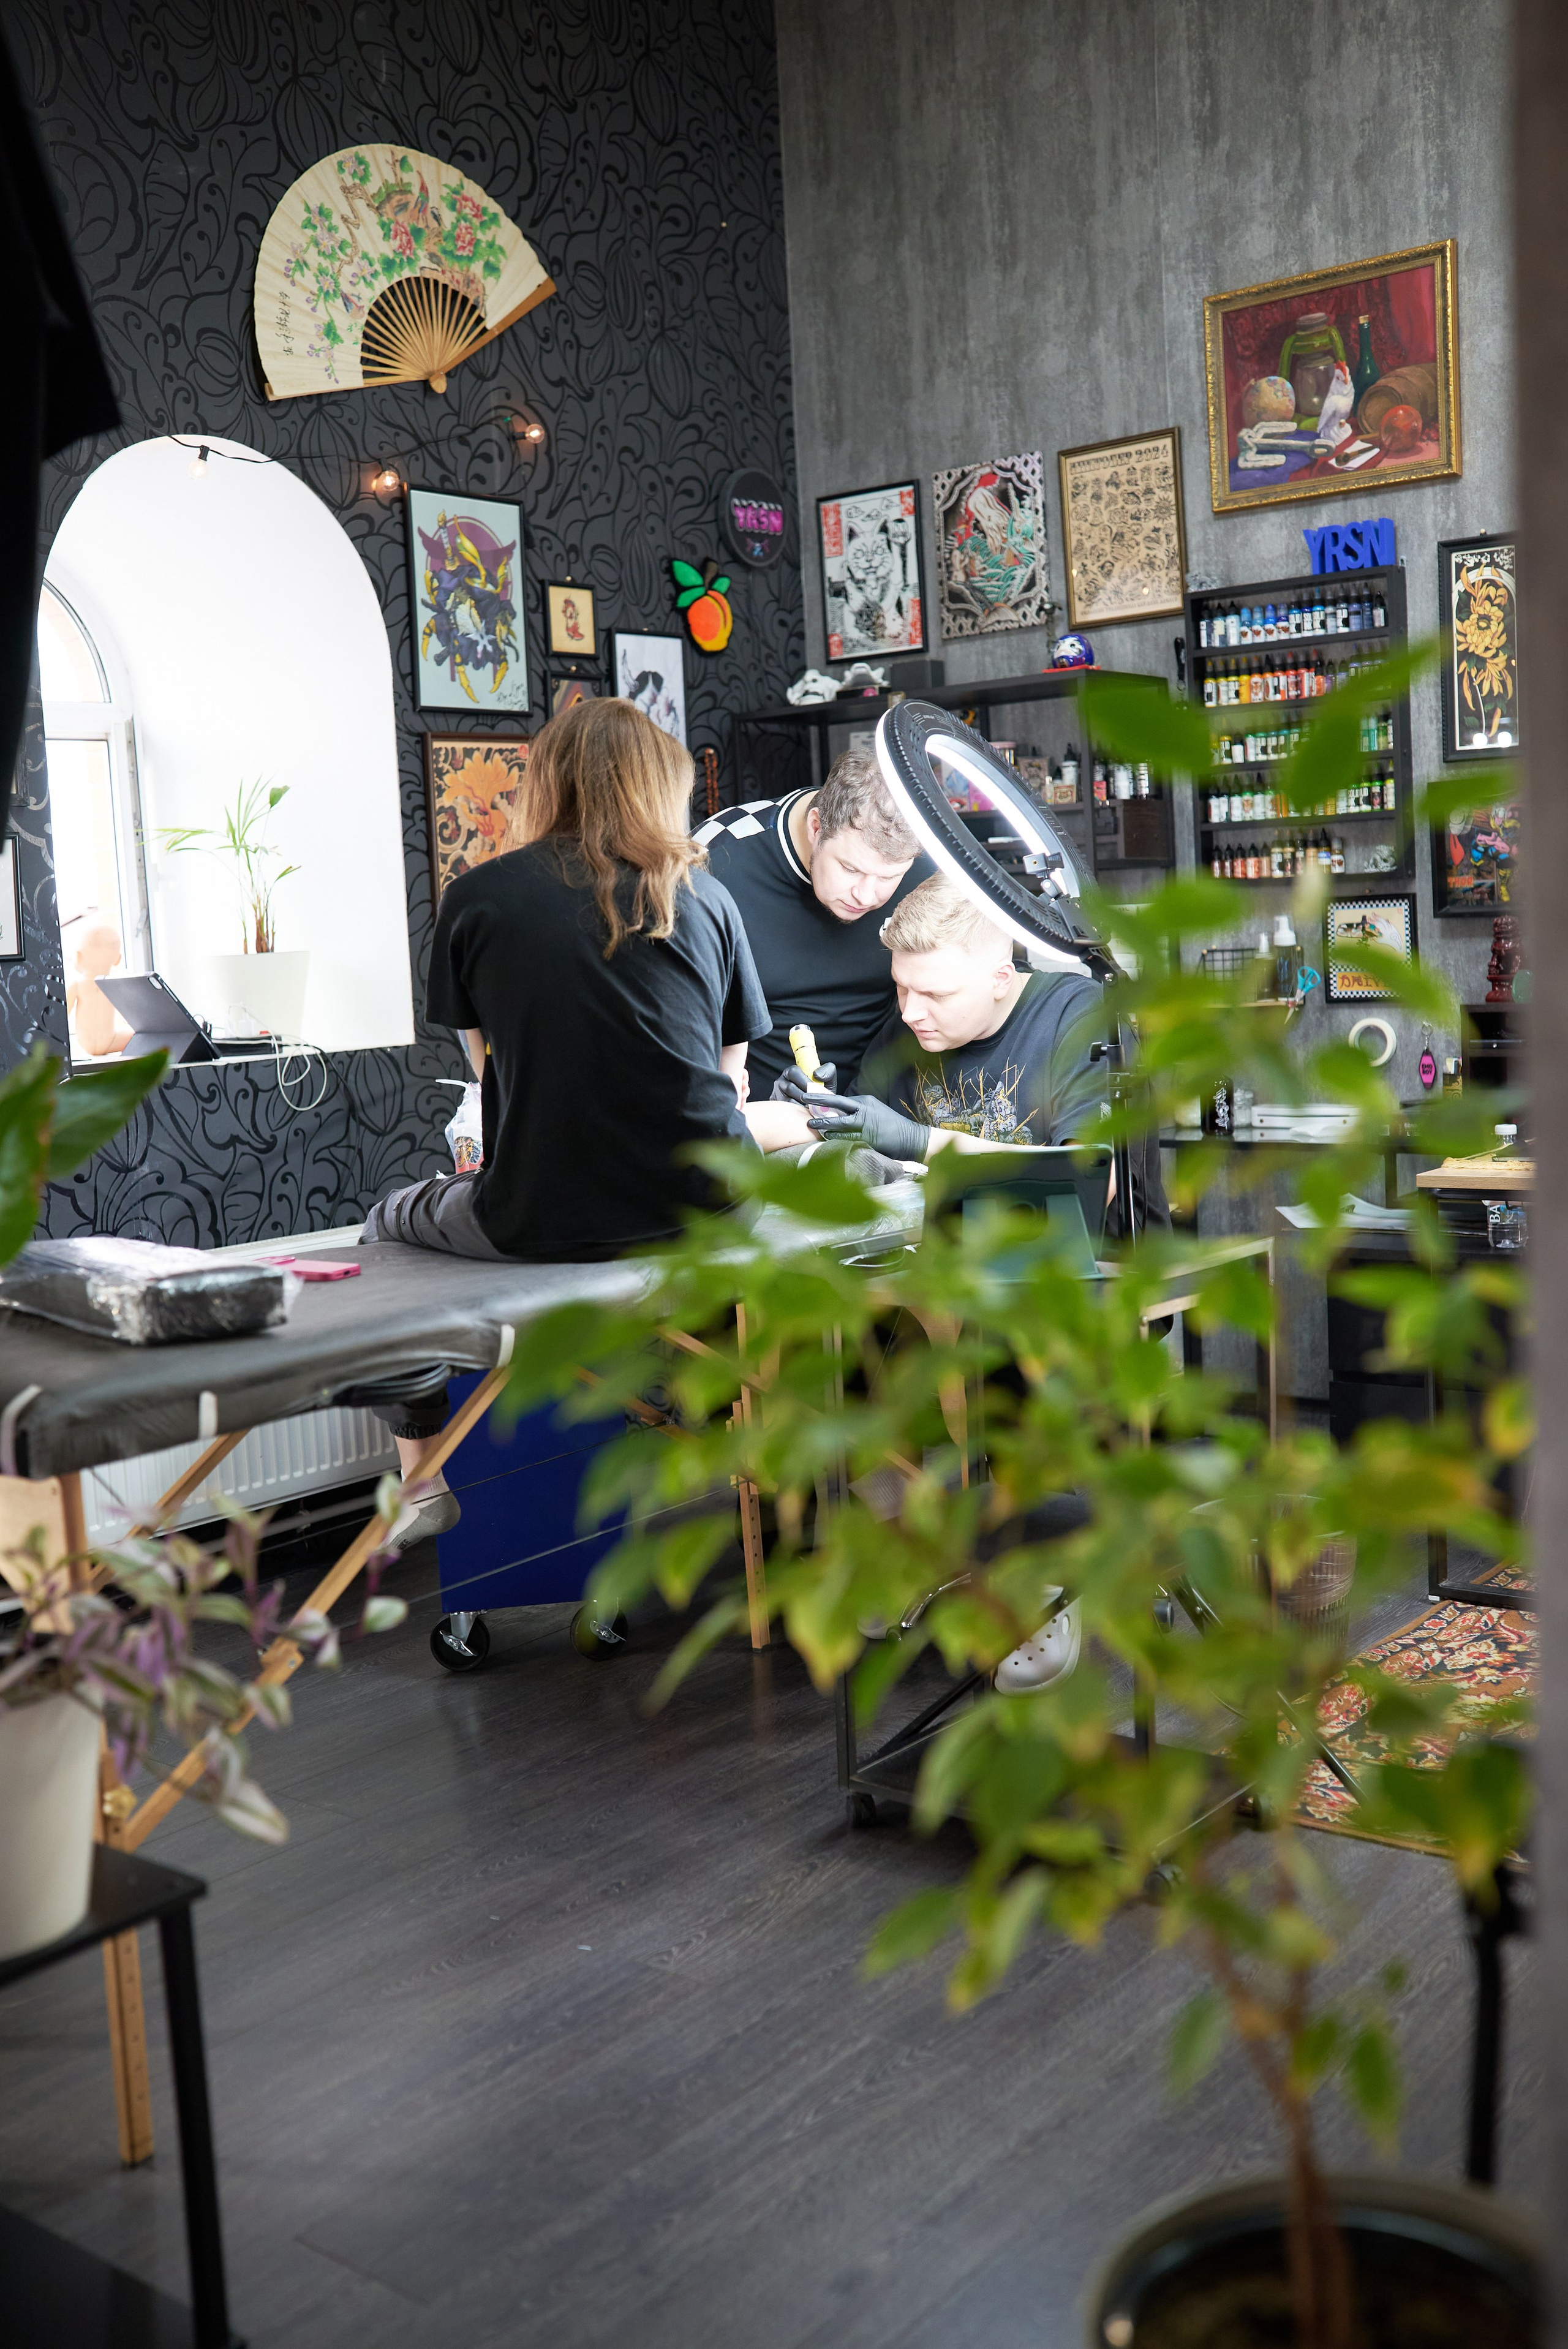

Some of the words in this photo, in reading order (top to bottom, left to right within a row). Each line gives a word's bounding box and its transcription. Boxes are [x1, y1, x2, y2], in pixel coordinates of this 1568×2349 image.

[1135, 444, 1169, 464] 2024
[731, 498, 783, 536] YRSN
[1302, 518, 1395, 575] YRSN
[1447, 876, 1474, 888] THOR
